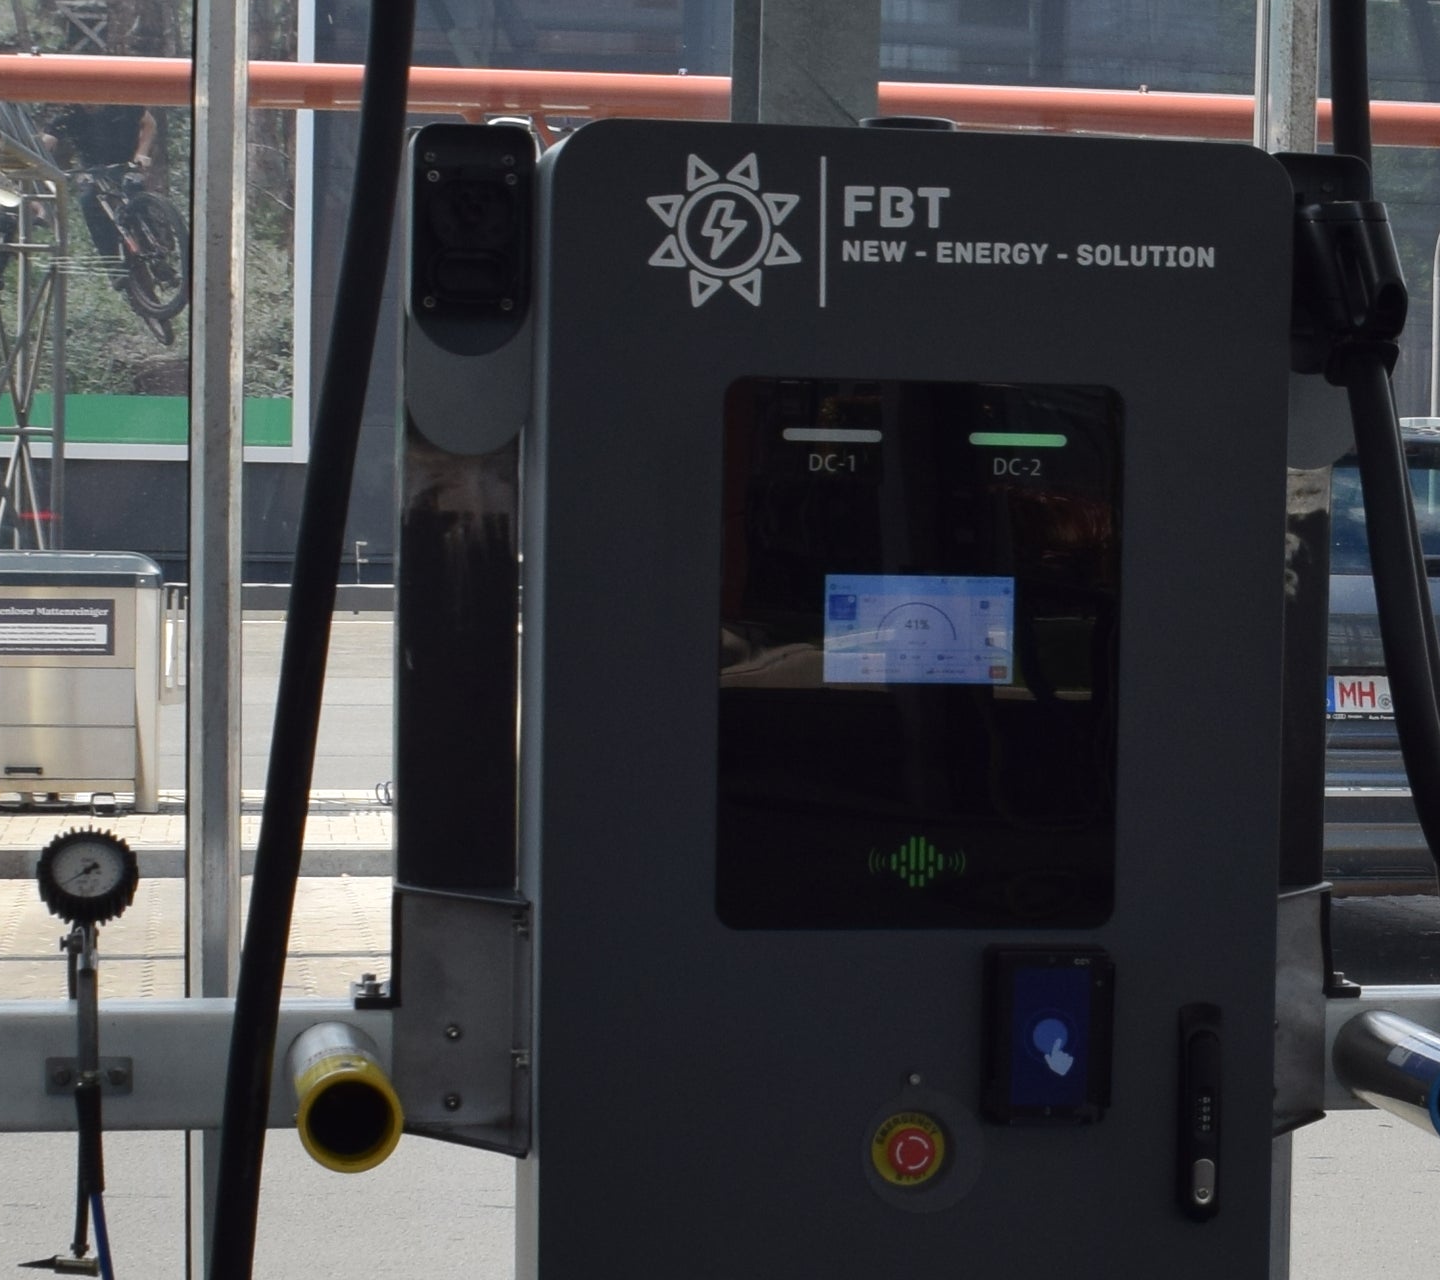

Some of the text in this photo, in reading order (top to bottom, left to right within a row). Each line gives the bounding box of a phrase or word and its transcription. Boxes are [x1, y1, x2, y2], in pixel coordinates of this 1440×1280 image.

[843, 186, 951, 228] FBT
[842, 241, 905, 262] NEW
[937, 243, 1048, 265] ENERGY
[1077, 245, 1216, 268] SOLUTION
[809, 454, 857, 472] DC-1
[993, 458, 1041, 476] DC-2
[36, 607, 109, 617] Mattenreiniger
[905, 619, 930, 630] 41%
[1338, 680, 1376, 708] MH
